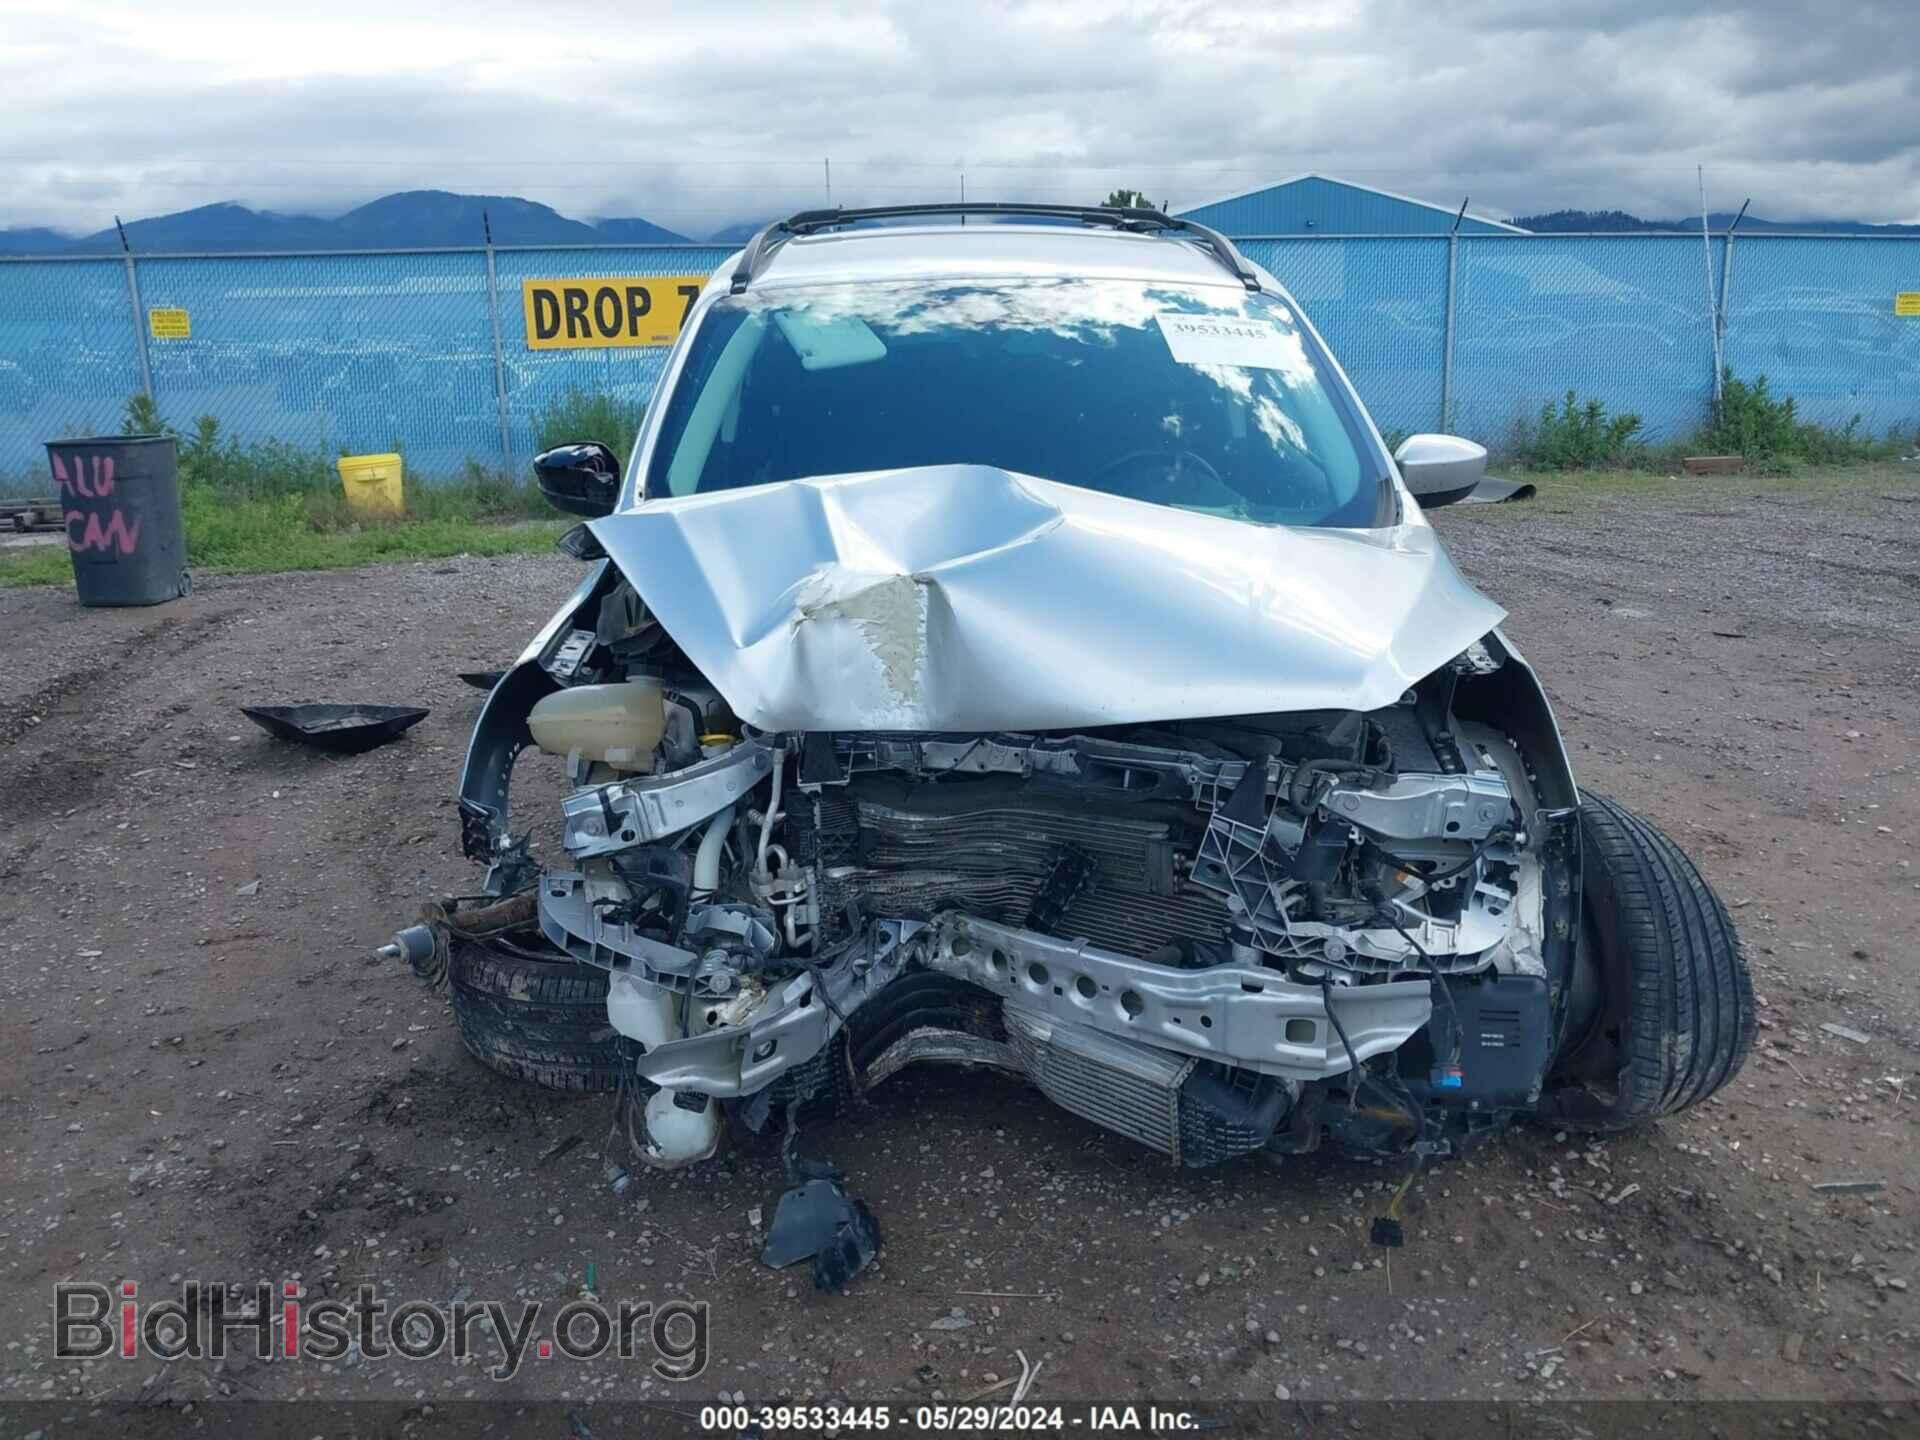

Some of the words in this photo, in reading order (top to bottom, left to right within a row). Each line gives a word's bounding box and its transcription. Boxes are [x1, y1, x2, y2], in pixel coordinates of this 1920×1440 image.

[532, 286, 652, 340] DROP
[1174, 322, 1267, 339] 39533445
[52, 450, 114, 497] ALU
[64, 509, 142, 554] CAN
